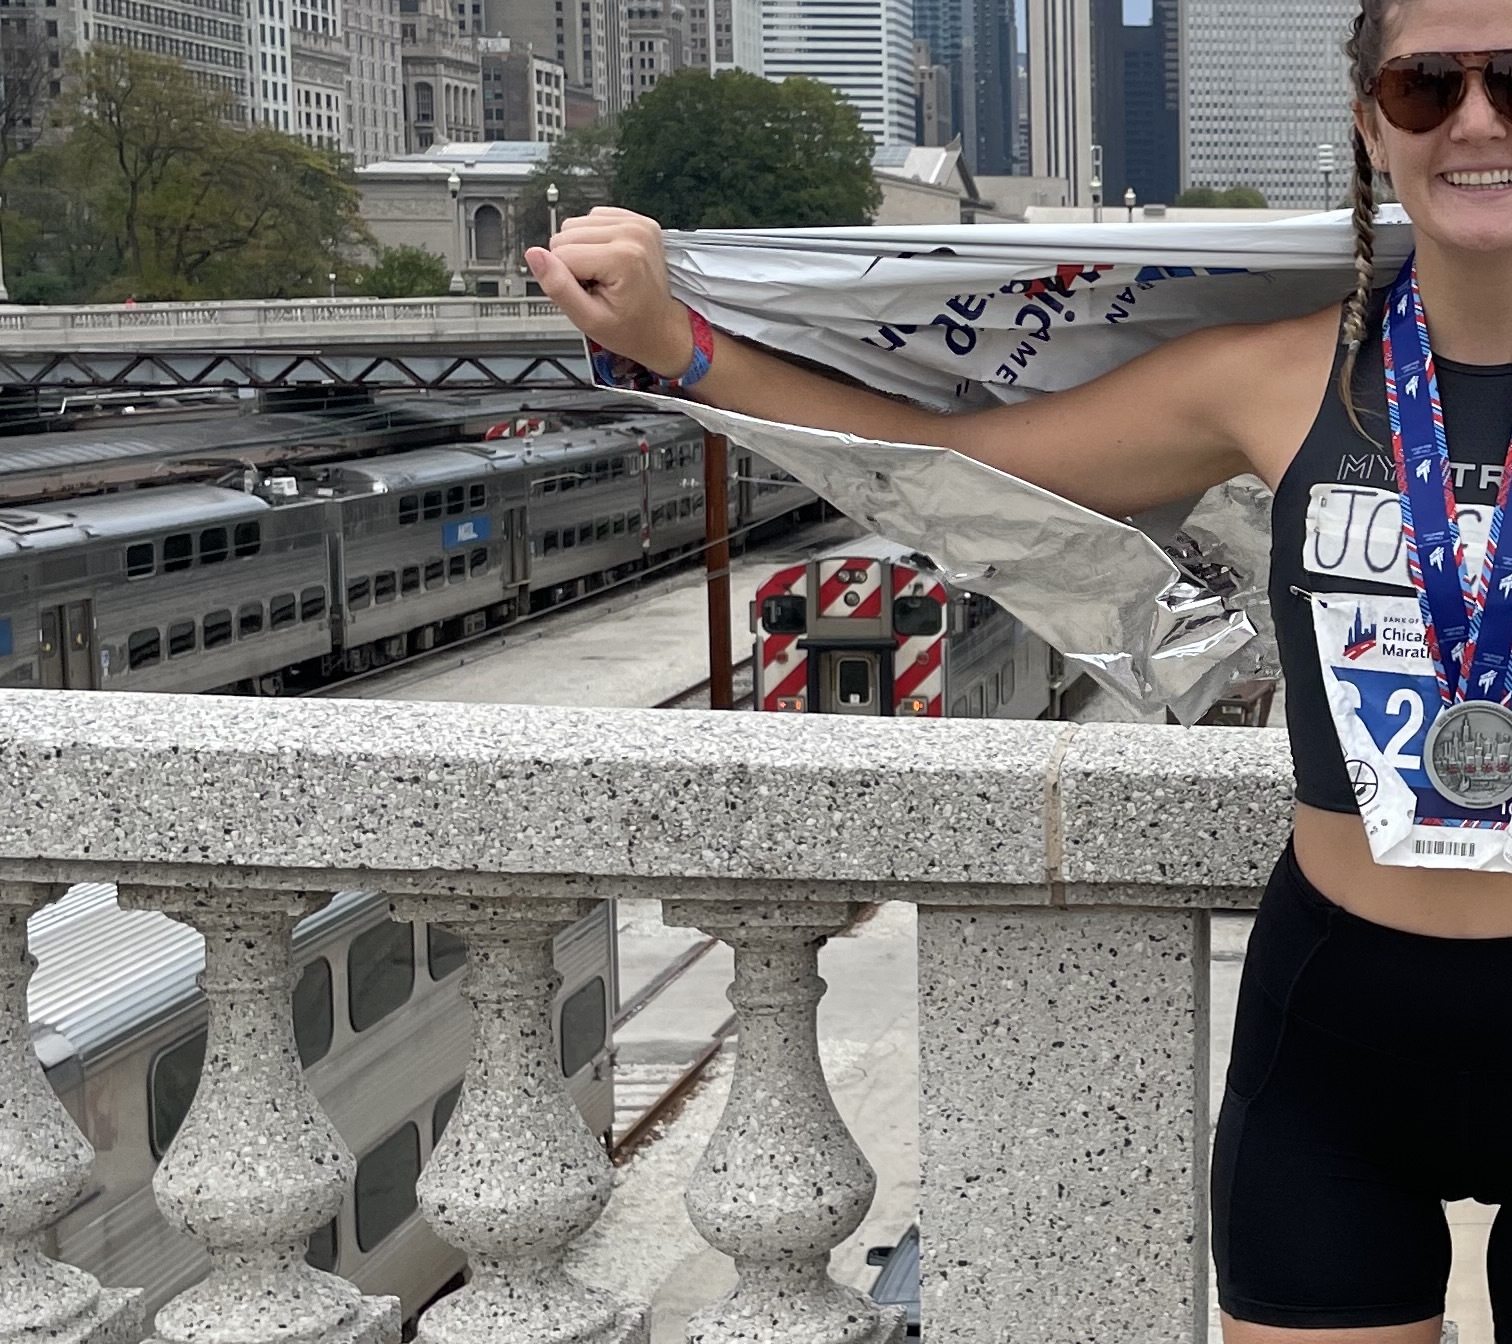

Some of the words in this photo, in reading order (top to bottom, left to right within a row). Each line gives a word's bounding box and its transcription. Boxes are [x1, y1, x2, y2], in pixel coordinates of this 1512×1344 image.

[1383, 616, 1407, 624] BANK
[1382, 627, 1429, 646] Chica
[1382, 643, 1430, 659] Marat
